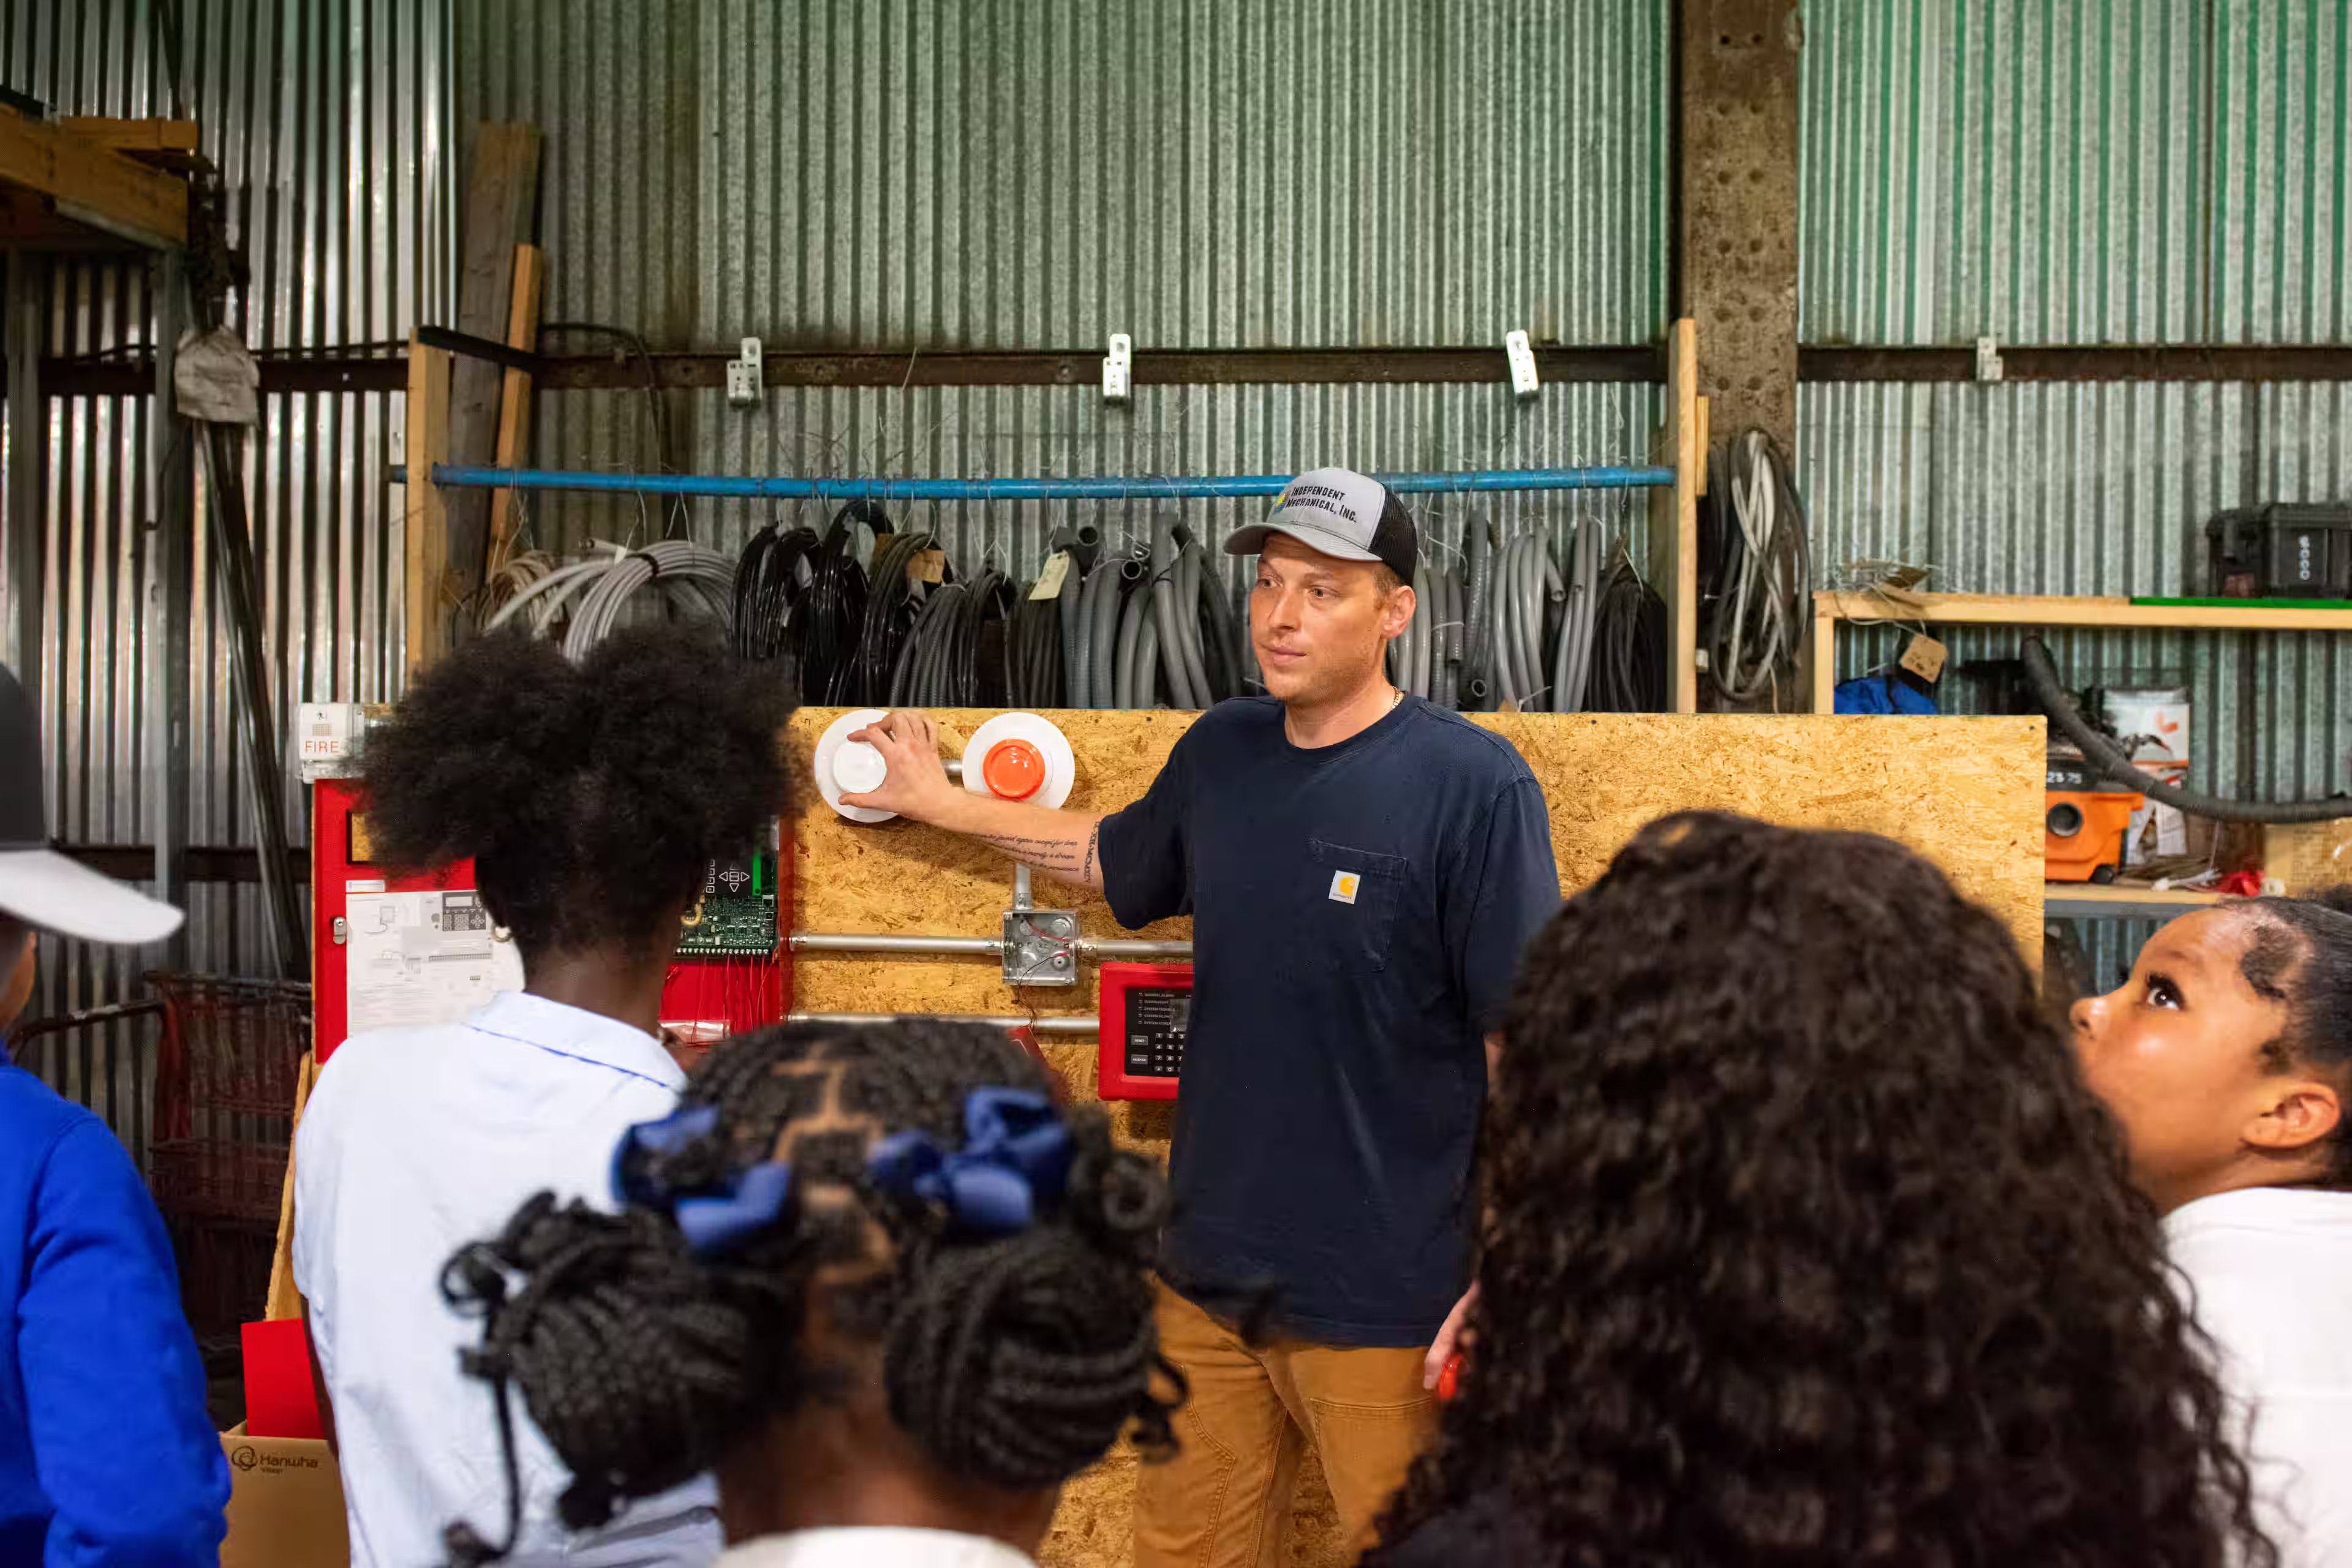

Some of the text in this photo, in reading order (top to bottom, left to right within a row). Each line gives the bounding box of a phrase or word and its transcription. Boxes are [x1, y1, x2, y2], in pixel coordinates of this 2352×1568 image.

[1291, 486, 1346, 500] INDEPENDENT
[1285, 497, 1357, 523] MECHANICAL, INC.
[305, 741, 339, 753] FIRE
[260, 1454, 318, 1468] Hanwha
